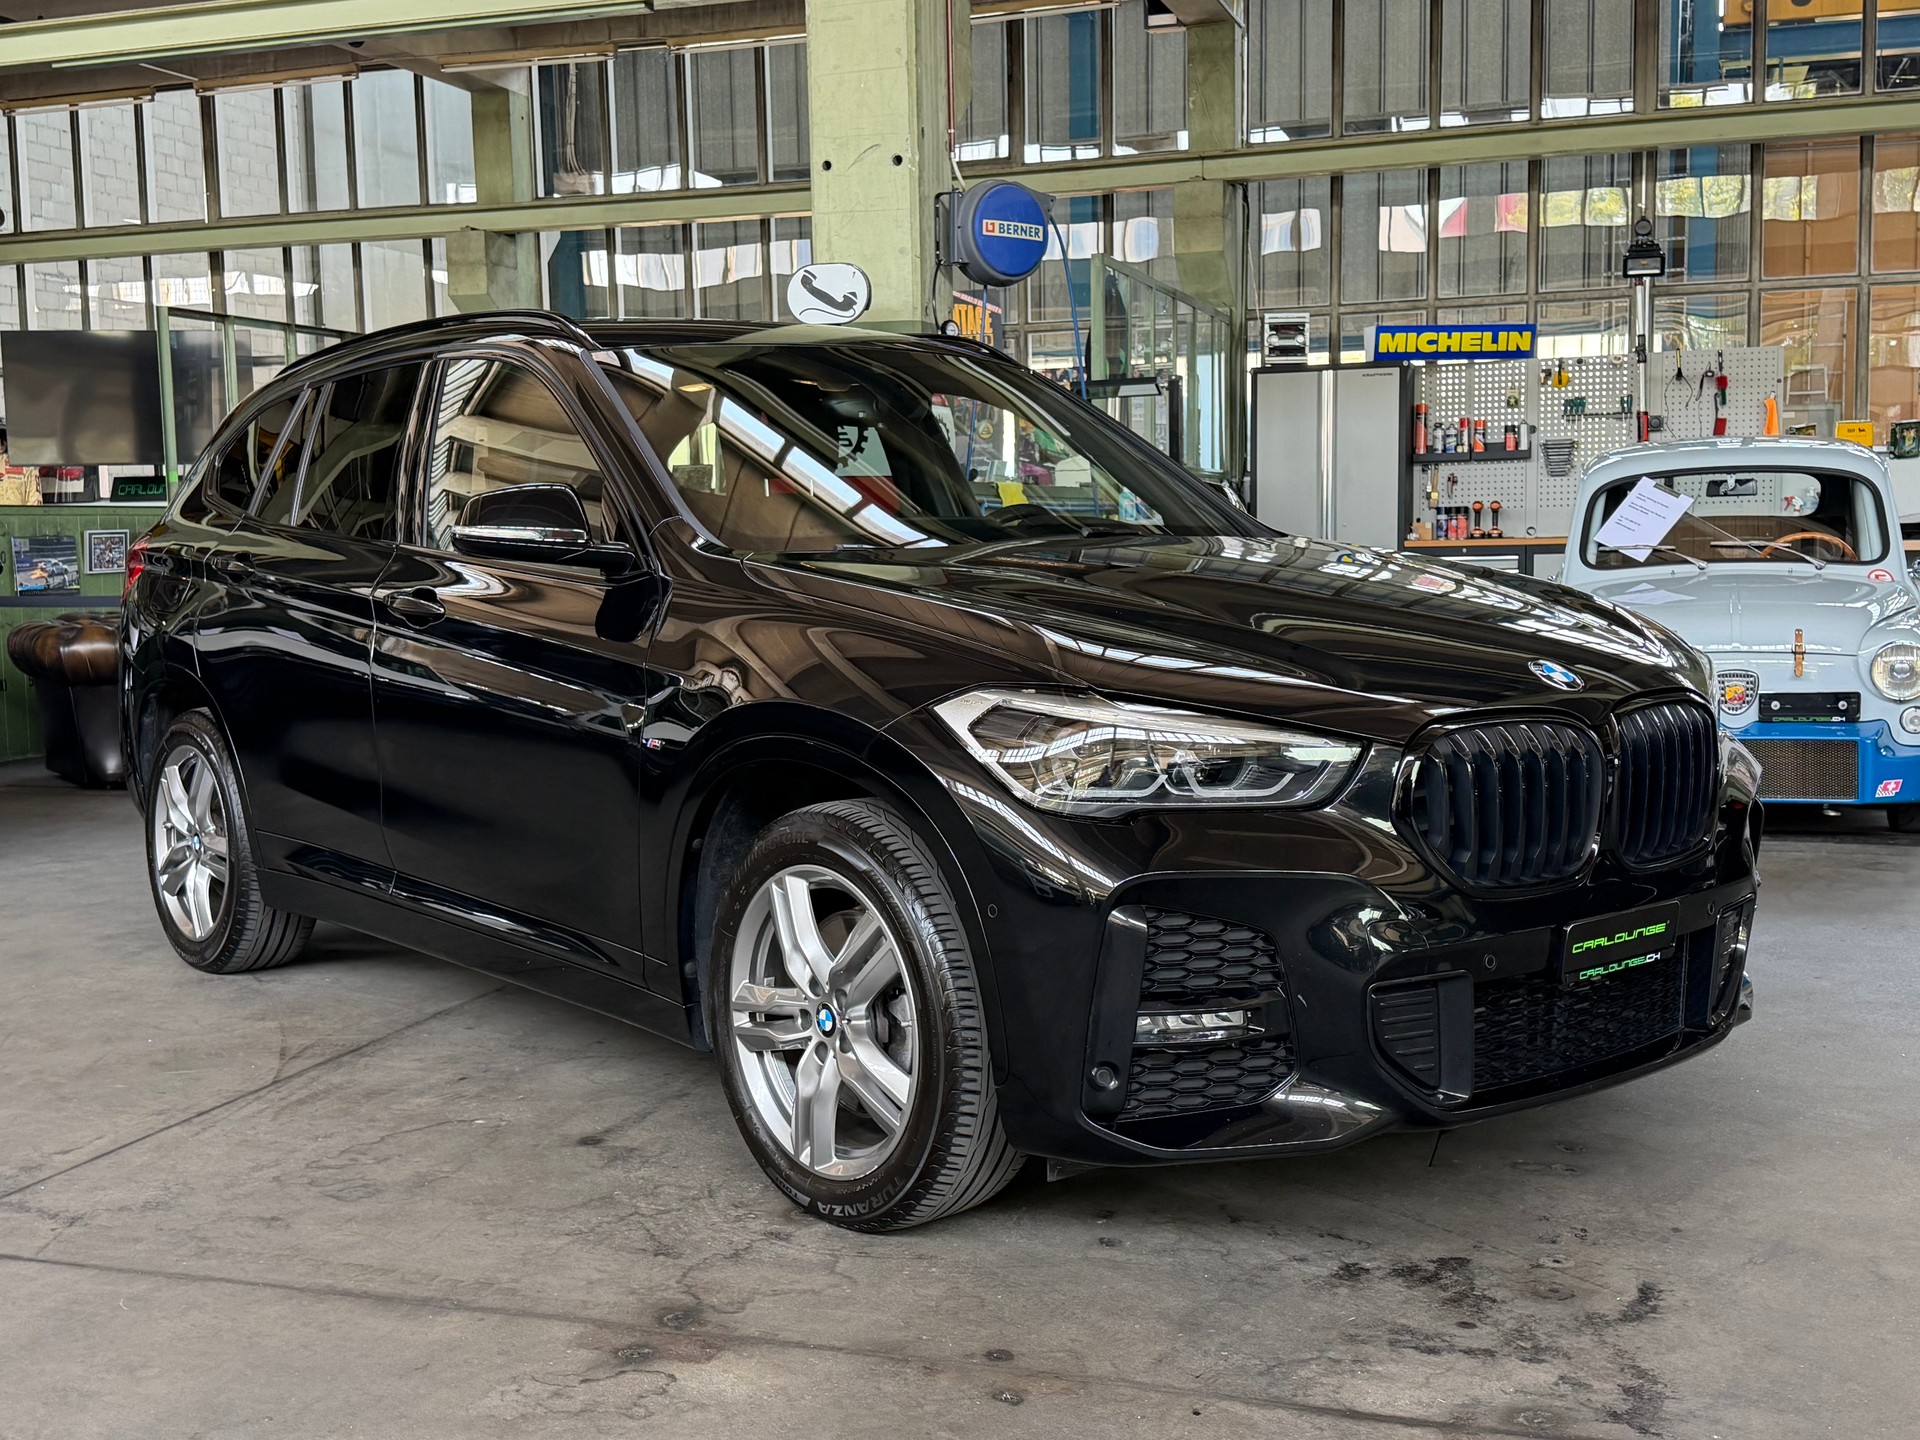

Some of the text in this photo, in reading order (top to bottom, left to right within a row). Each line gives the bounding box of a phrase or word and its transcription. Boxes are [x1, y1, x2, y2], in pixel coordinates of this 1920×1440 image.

[998, 222, 1041, 239] BERNER
[1378, 331, 1532, 353] MICHELIN
[1571, 922, 1667, 954] CARLOUNGE
[1579, 951, 1661, 980] CARLOUNGE.CH
[816, 1177, 906, 1217] TURANZA
